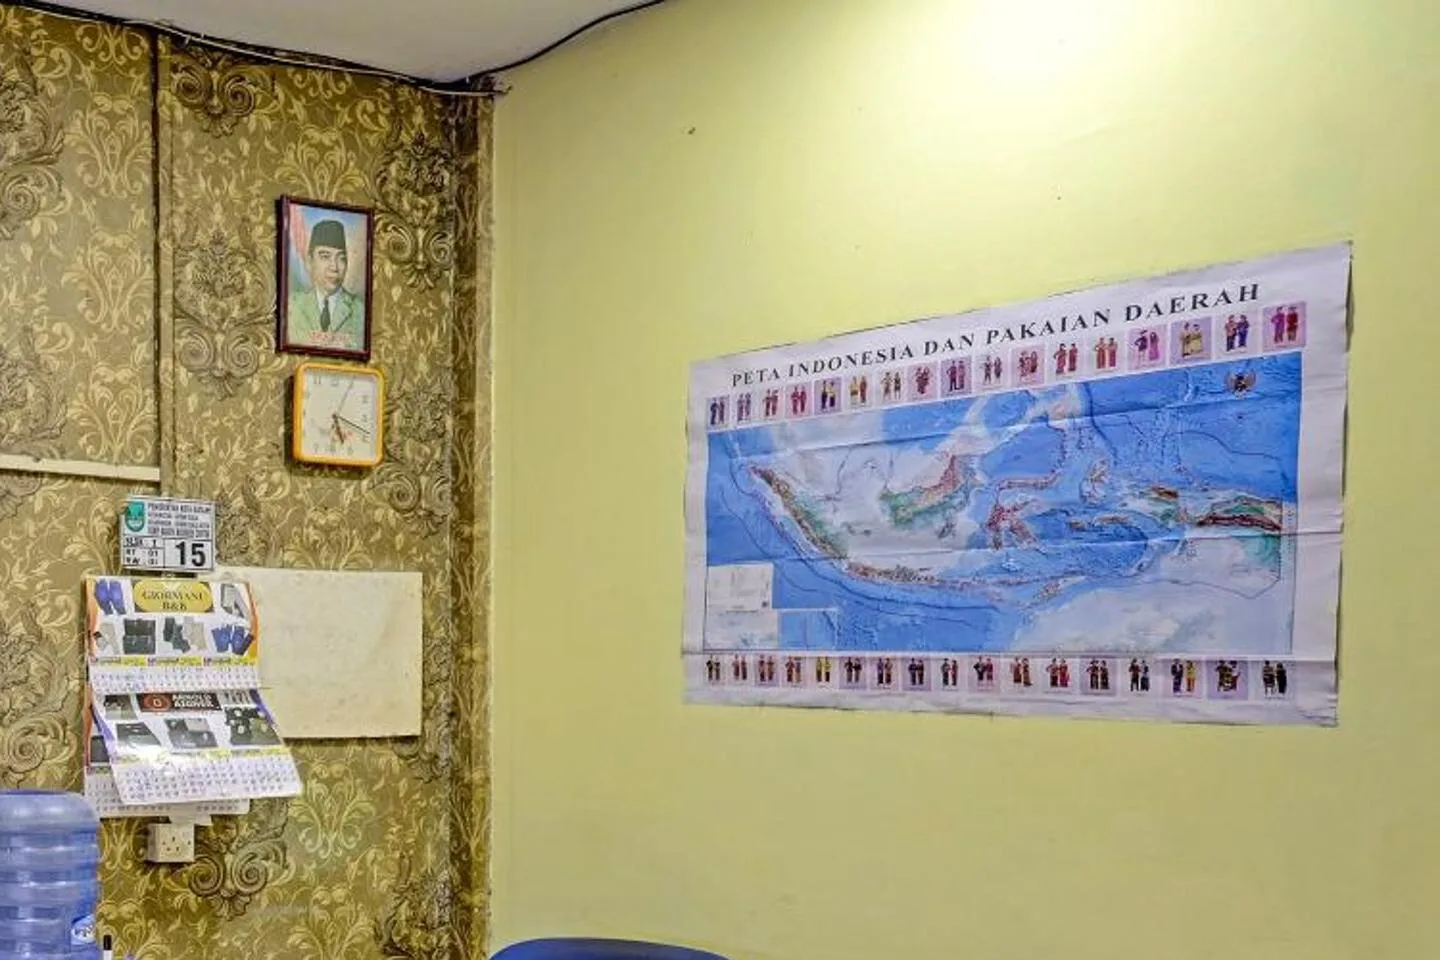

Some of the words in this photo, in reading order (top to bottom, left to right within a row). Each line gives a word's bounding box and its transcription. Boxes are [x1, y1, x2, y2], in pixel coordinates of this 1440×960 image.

[731, 366, 781, 388] PETA
[788, 344, 914, 378] INDONESIA
[924, 332, 976, 356] DAN
[986, 308, 1111, 345] PAKAIAN
[1125, 283, 1260, 322] DAERAH
[175, 541, 206, 567] 15
